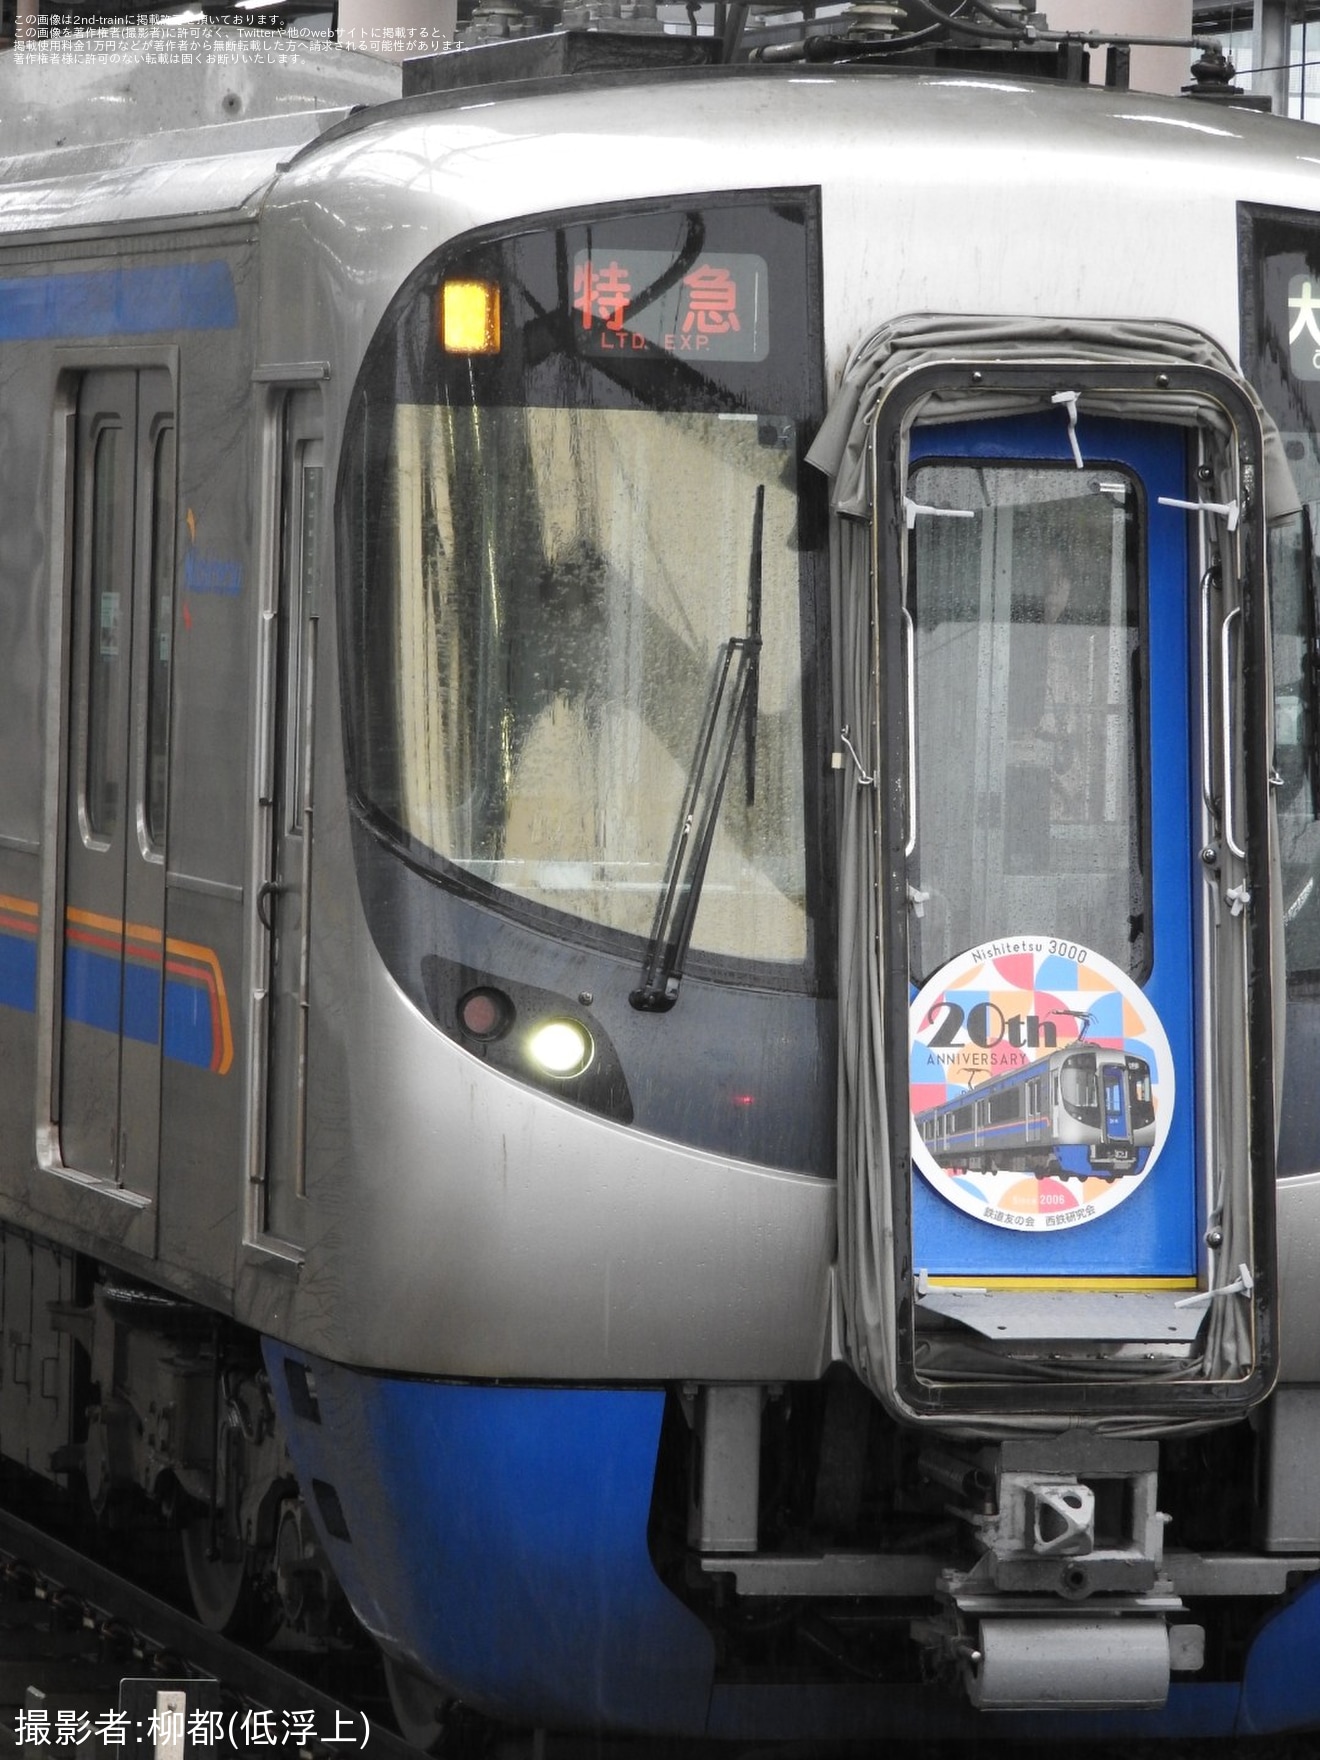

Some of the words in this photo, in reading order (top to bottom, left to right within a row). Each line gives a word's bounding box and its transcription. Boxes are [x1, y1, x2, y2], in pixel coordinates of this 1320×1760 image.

[573, 261, 741, 333] 特急
[971, 940, 1043, 963] Nishitetsu
[1048, 939, 1088, 964] 3000
[927, 1002, 1057, 1049] 20th
[927, 1052, 1027, 1066] ANNIVERSARY
[1039, 1194, 1065, 1205] 2006
[983, 1206, 1035, 1227] 鉄道友の会
[1045, 1204, 1096, 1227] 西鉄研究会
